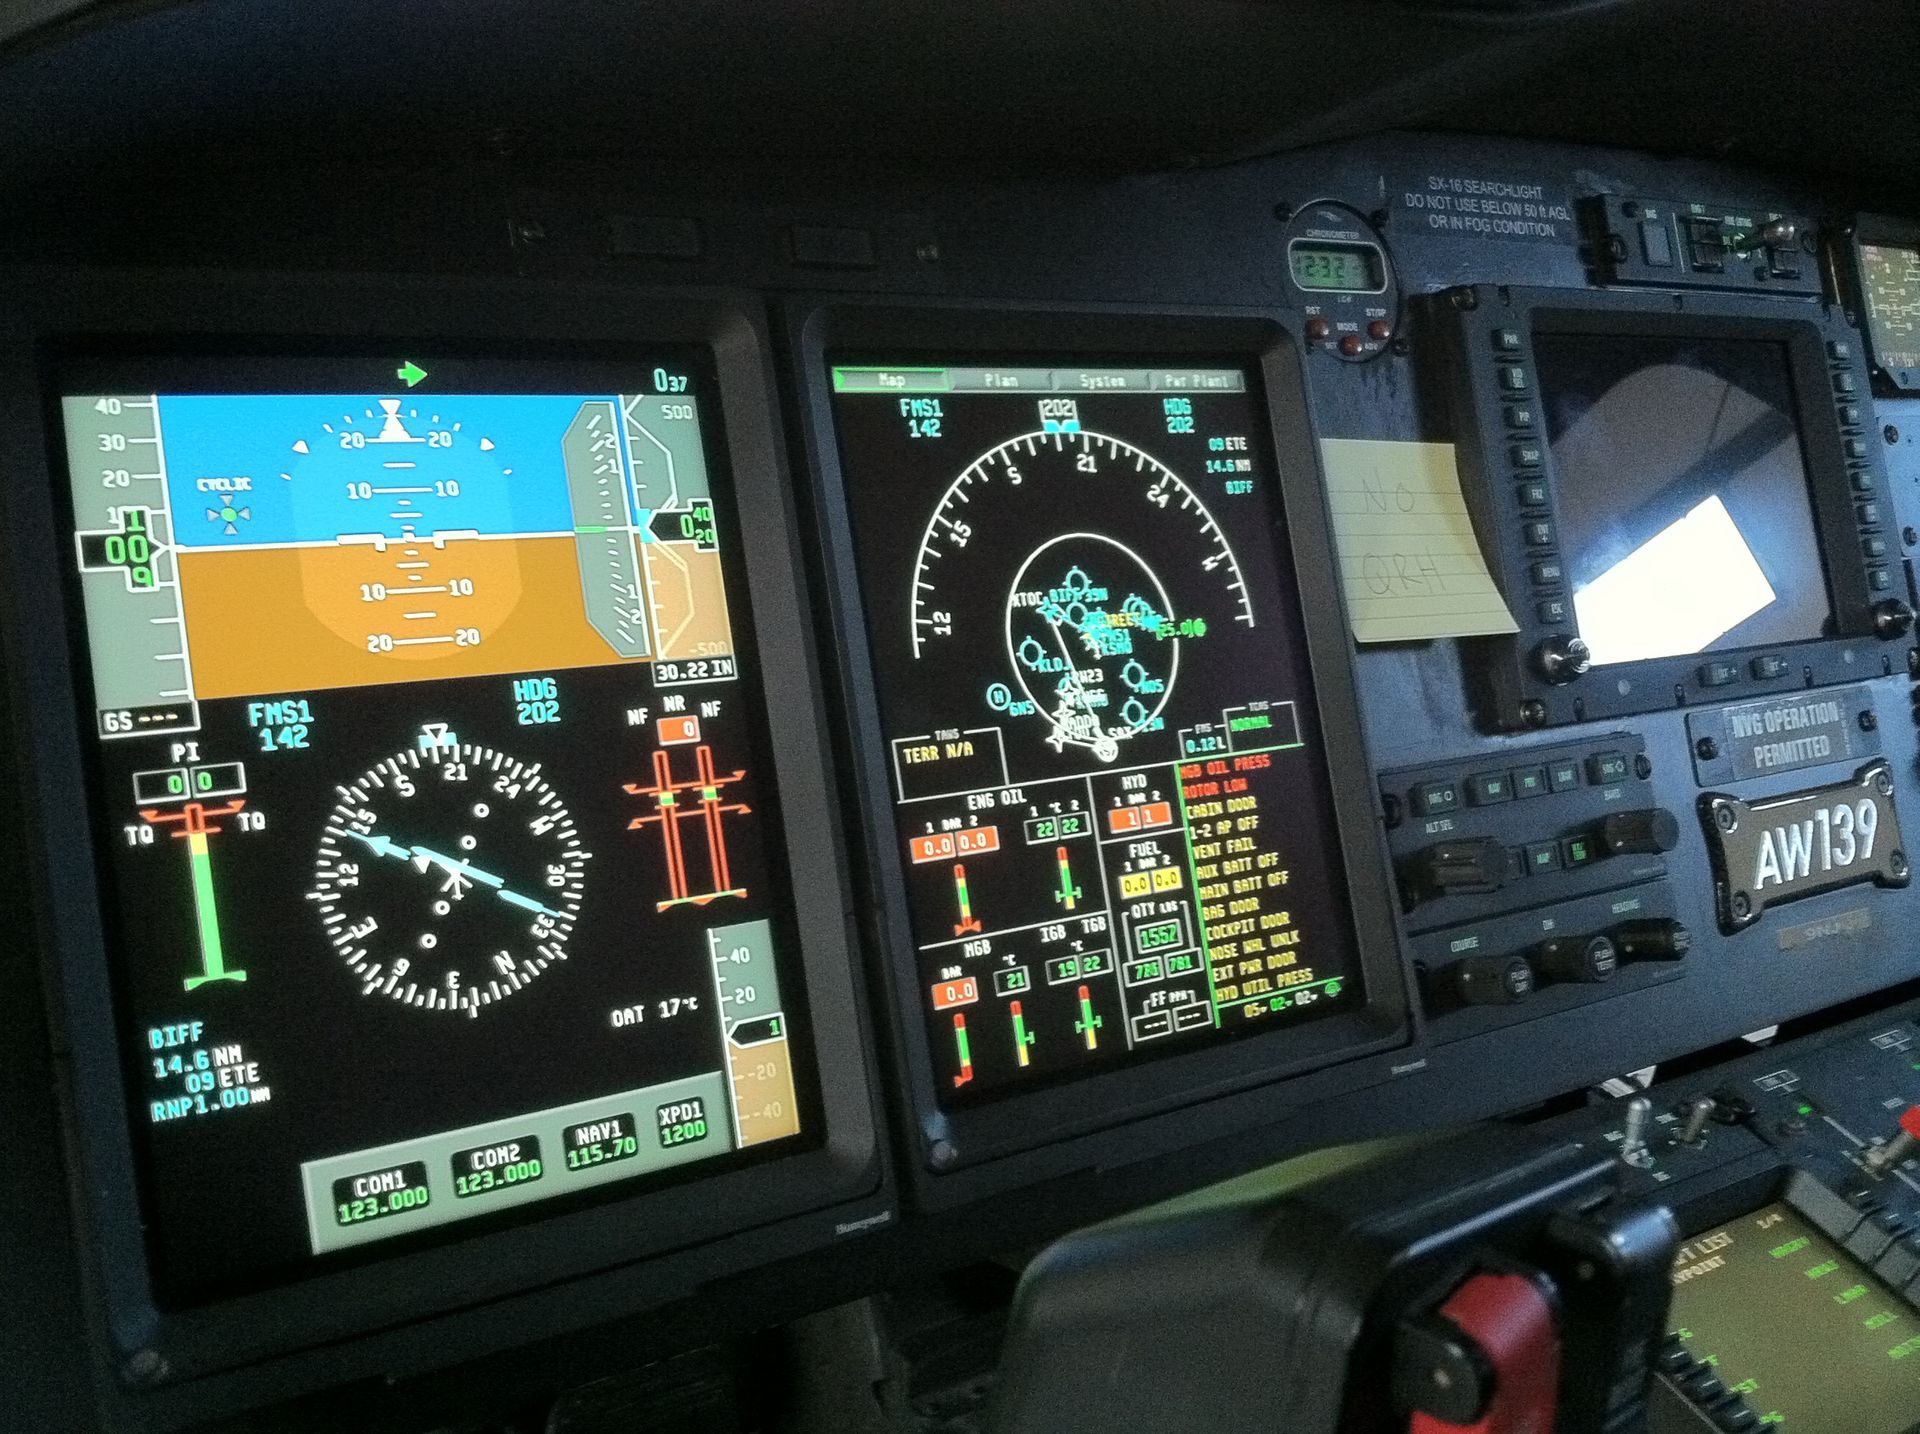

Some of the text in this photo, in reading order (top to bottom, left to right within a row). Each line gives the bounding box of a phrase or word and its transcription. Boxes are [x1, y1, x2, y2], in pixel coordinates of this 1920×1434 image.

[1464, 179, 1542, 199] SEARCHLIGHT
[1405, 193, 1424, 208] DO
[1426, 195, 1452, 211] NOT
[1456, 198, 1480, 213] USE
[1481, 200, 1522, 217] BELOW
[1523, 204, 1537, 218] 50
[1548, 206, 1571, 221] AGL
[1429, 214, 1556, 237] OR IN FOG CONDITION
[878, 373, 907, 389] Map
[984, 373, 1018, 388] Plan
[1079, 373, 1126, 390] System
[95, 399, 121, 415] 40
[662, 404, 693, 420] 500
[900, 399, 943, 418] FMS1
[1044, 401, 1074, 418] 202
[1164, 398, 1192, 416] HDG
[909, 419, 943, 438] 142
[1167, 417, 1195, 434] 202
[98, 434, 126, 451] 30
[339, 432, 365, 449] 20
[427, 431, 453, 449] 20
[1225, 437, 1247, 452] ETE
[1077, 454, 1098, 474] 21
[1205, 459, 1235, 474] 14.6
[102, 471, 130, 487] 20
[196, 476, 252, 492] CYCLIC
[435, 481, 459, 497] 10
[347, 483, 372, 500] 10
[1146, 484, 1171, 509] 24
[1362, 467, 1415, 513] NO
[950, 519, 972, 548] 15
[448, 579, 473, 597] 10
[932, 611, 952, 635] 12
[657, 660, 733, 681] 30.22 IN
[513, 677, 558, 702] HDG
[249, 700, 315, 727] FMS1
[517, 700, 562, 725] 202
[663, 695, 686, 712] NR
[701, 700, 721, 718] NF
[103, 712, 133, 732] GS
[627, 708, 648, 726] NF
[1764, 701, 1839, 733] OPERATION
[259, 724, 310, 751] 142
[171, 742, 201, 763] PI
[903, 741, 974, 764] TERR N/A
[1753, 735, 1830, 768] PERMITTED
[443, 762, 468, 781] 21
[1234, 754, 1272, 771] PRESS
[493, 775, 521, 799] 24
[1121, 774, 1147, 791] HYD
[967, 789, 1027, 811] ENG OIL
[1186, 796, 1257, 820] CABIN DOOR
[237, 812, 266, 832] TQ
[352, 808, 377, 835] 15
[1062, 818, 1079, 834] 22
[1237, 815, 1259, 831] OFF
[124, 825, 154, 845] TQ
[960, 832, 987, 850] 0.0
[1753, 798, 1878, 890] AW139
[923, 838, 950, 856] 0.0
[1129, 841, 1162, 858] FUEL
[1193, 837, 1257, 860] VENT FAIL
[338, 863, 359, 887] 12
[547, 864, 566, 887] 30
[1196, 852, 1279, 880] AUX BATT OFF
[1155, 871, 1178, 887] 0.0
[1232, 876, 1262, 894] BATT
[1267, 870, 1289, 886] OFF
[1131, 901, 1155, 919] QTY
[1229, 897, 1260, 915] DOOR
[530, 914, 555, 939] 33
[1039, 925, 1066, 943] IGB
[1081, 916, 1106, 934] TGB
[1205, 911, 1291, 941] COCKPIT DOOR
[730, 947, 750, 964] 40
[1209, 943, 1239, 961] NOSE
[1270, 930, 1300, 948] UNLK
[1057, 961, 1076, 978] 19
[1083, 955, 1101, 972] 22
[1212, 964, 1235, 982] EXT
[1267, 951, 1297, 969] DOOR
[1006, 972, 1025, 989] 21
[1215, 968, 1313, 1002] HYD UTIL PRESS
[735, 986, 756, 1004] 20
[946, 983, 974, 1002] 0.0
[1150, 990, 1167, 1008] FF
[610, 1004, 645, 1028] OAT
[149, 1021, 203, 1050] BIFF
[153, 1044, 243, 1078] 14.6 NM
[185, 1062, 260, 1093] 09 ETE
[658, 1101, 703, 1126] XPD1
[575, 1120, 622, 1146] NAV1
[661, 1120, 707, 1146] 1200
[471, 1143, 521, 1171] COM2
[568, 1136, 637, 1168] 115.70
[353, 1170, 406, 1198] COM1
[456, 1159, 542, 1195] 123.000
[338, 1186, 429, 1223] 123.000
